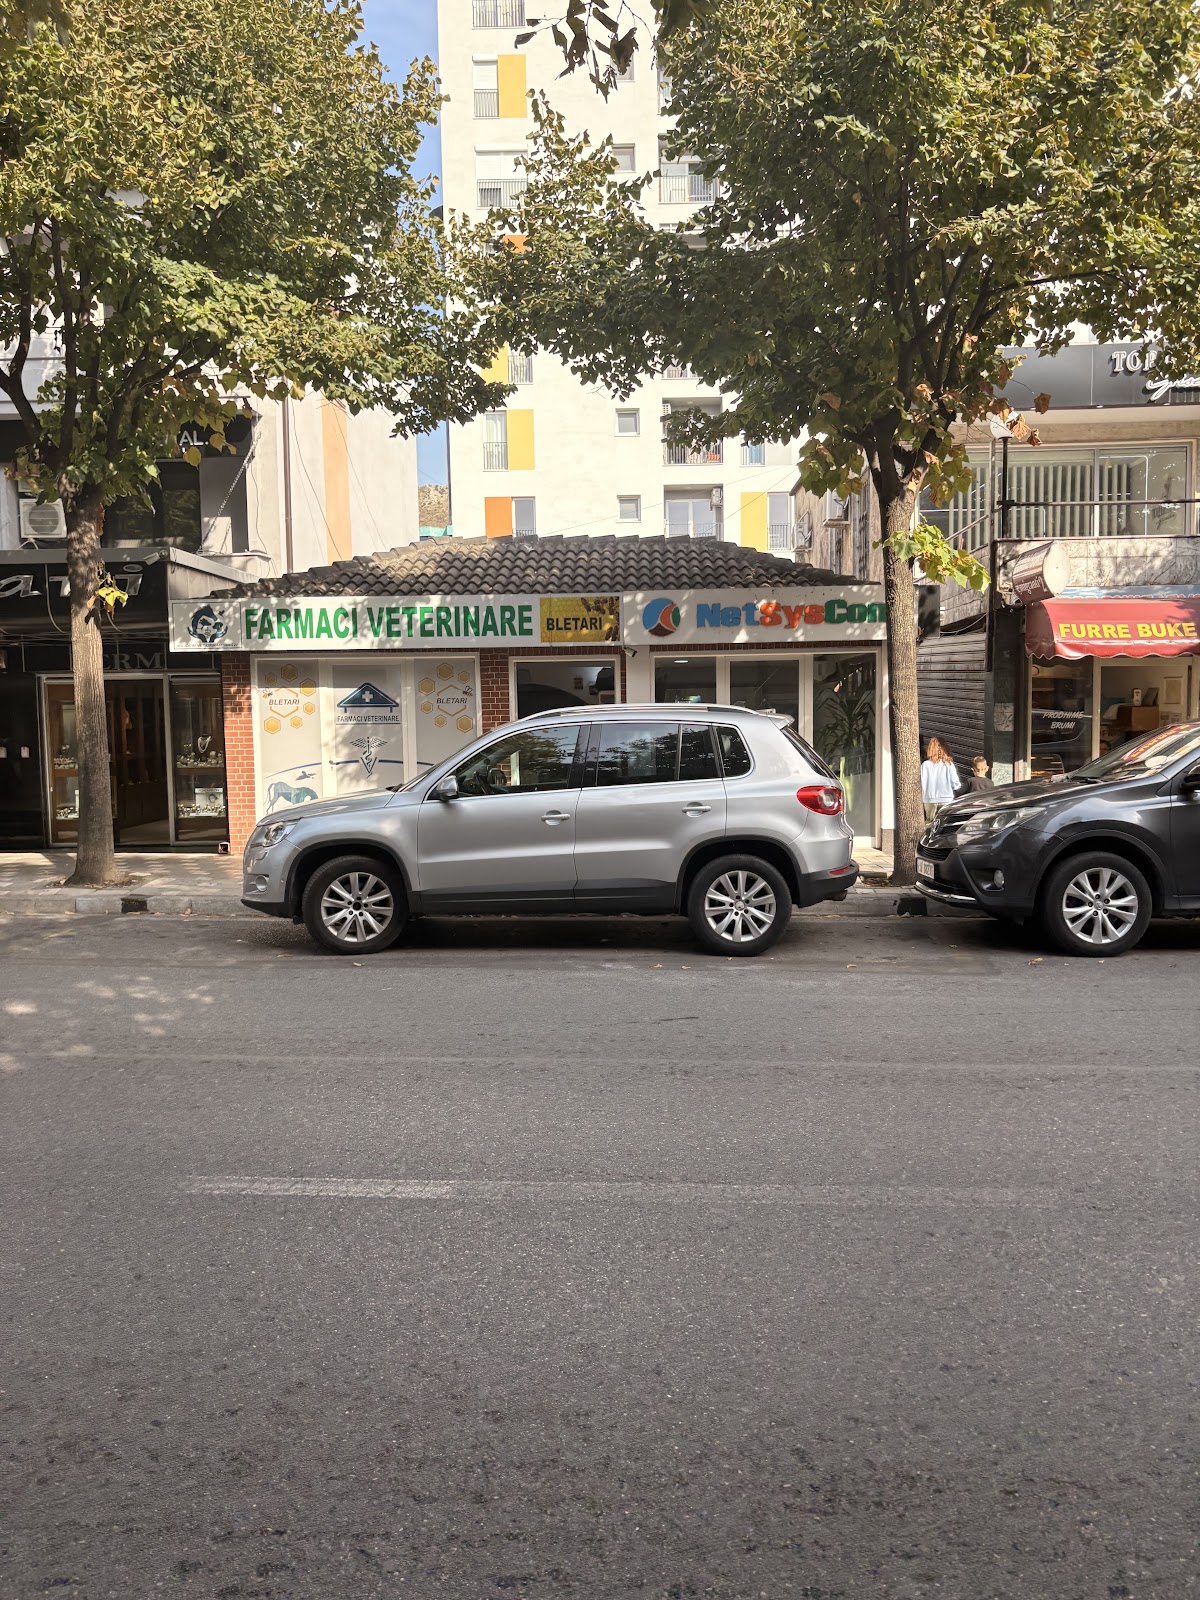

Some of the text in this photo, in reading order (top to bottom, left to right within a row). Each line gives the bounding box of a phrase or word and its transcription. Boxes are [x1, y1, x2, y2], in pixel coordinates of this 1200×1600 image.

[244, 604, 534, 640] FARMACI VETERINARE
[546, 616, 603, 631] BLETARI
[1058, 622, 1198, 639] FURRE BUKE
[337, 715, 363, 723] FARMACI
[1050, 721, 1077, 729] BRUMI
